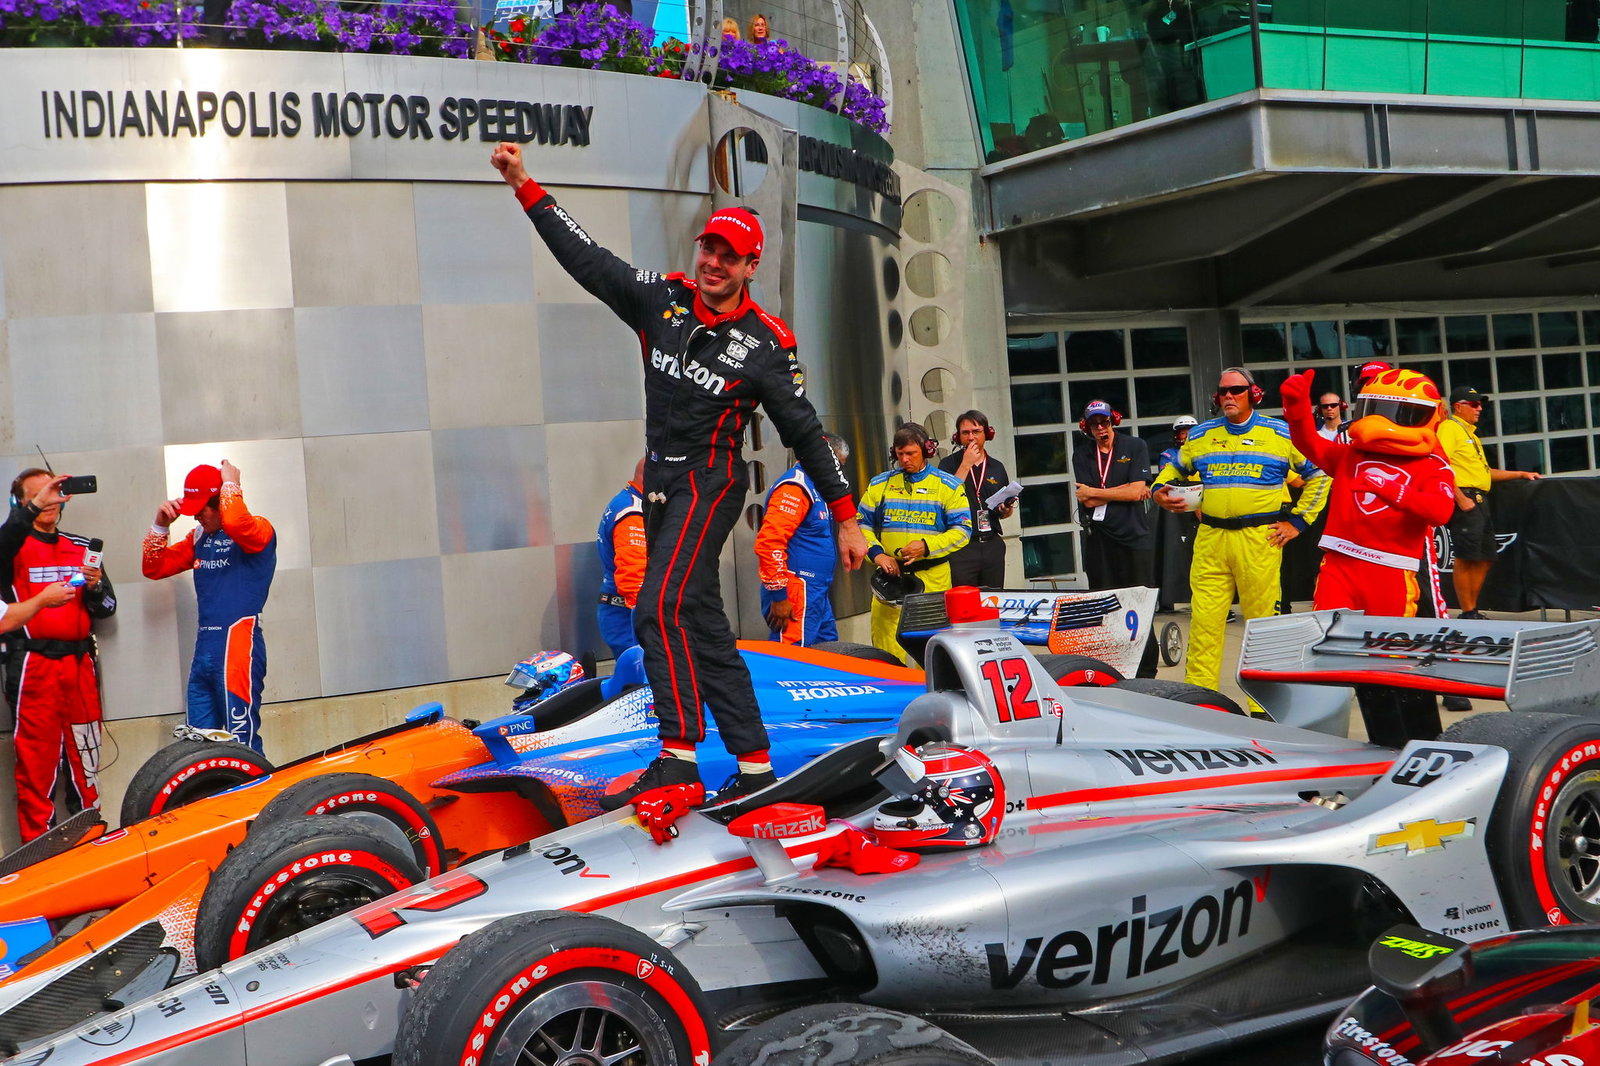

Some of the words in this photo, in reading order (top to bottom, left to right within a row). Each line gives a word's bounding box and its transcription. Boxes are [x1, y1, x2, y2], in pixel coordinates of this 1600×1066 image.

[41, 90, 301, 138] INDIANAPOLIS
[313, 92, 434, 140] MOTOR
[439, 97, 594, 147] SPEEDWAY
[552, 206, 592, 246] verizon
[717, 353, 744, 369] SKF
[1207, 462, 1265, 473] INDYCAR
[884, 508, 937, 521] INDYCAR
[1337, 543, 1383, 560] FIREHAWK
[1125, 609, 1139, 642] 9
[787, 685, 885, 702] HONDA
[980, 657, 1042, 724] 12
[510, 720, 532, 733] PNC
[1105, 747, 1278, 777] verizon
[163, 758, 251, 795] Firestone
[753, 815, 825, 840] Mazak
[238, 852, 353, 934] Firestone
[775, 885, 866, 903] Firestone
[1465, 903, 1492, 915] verizon
[984, 879, 1256, 991] verizon
[1441, 919, 1500, 936] Firestone
